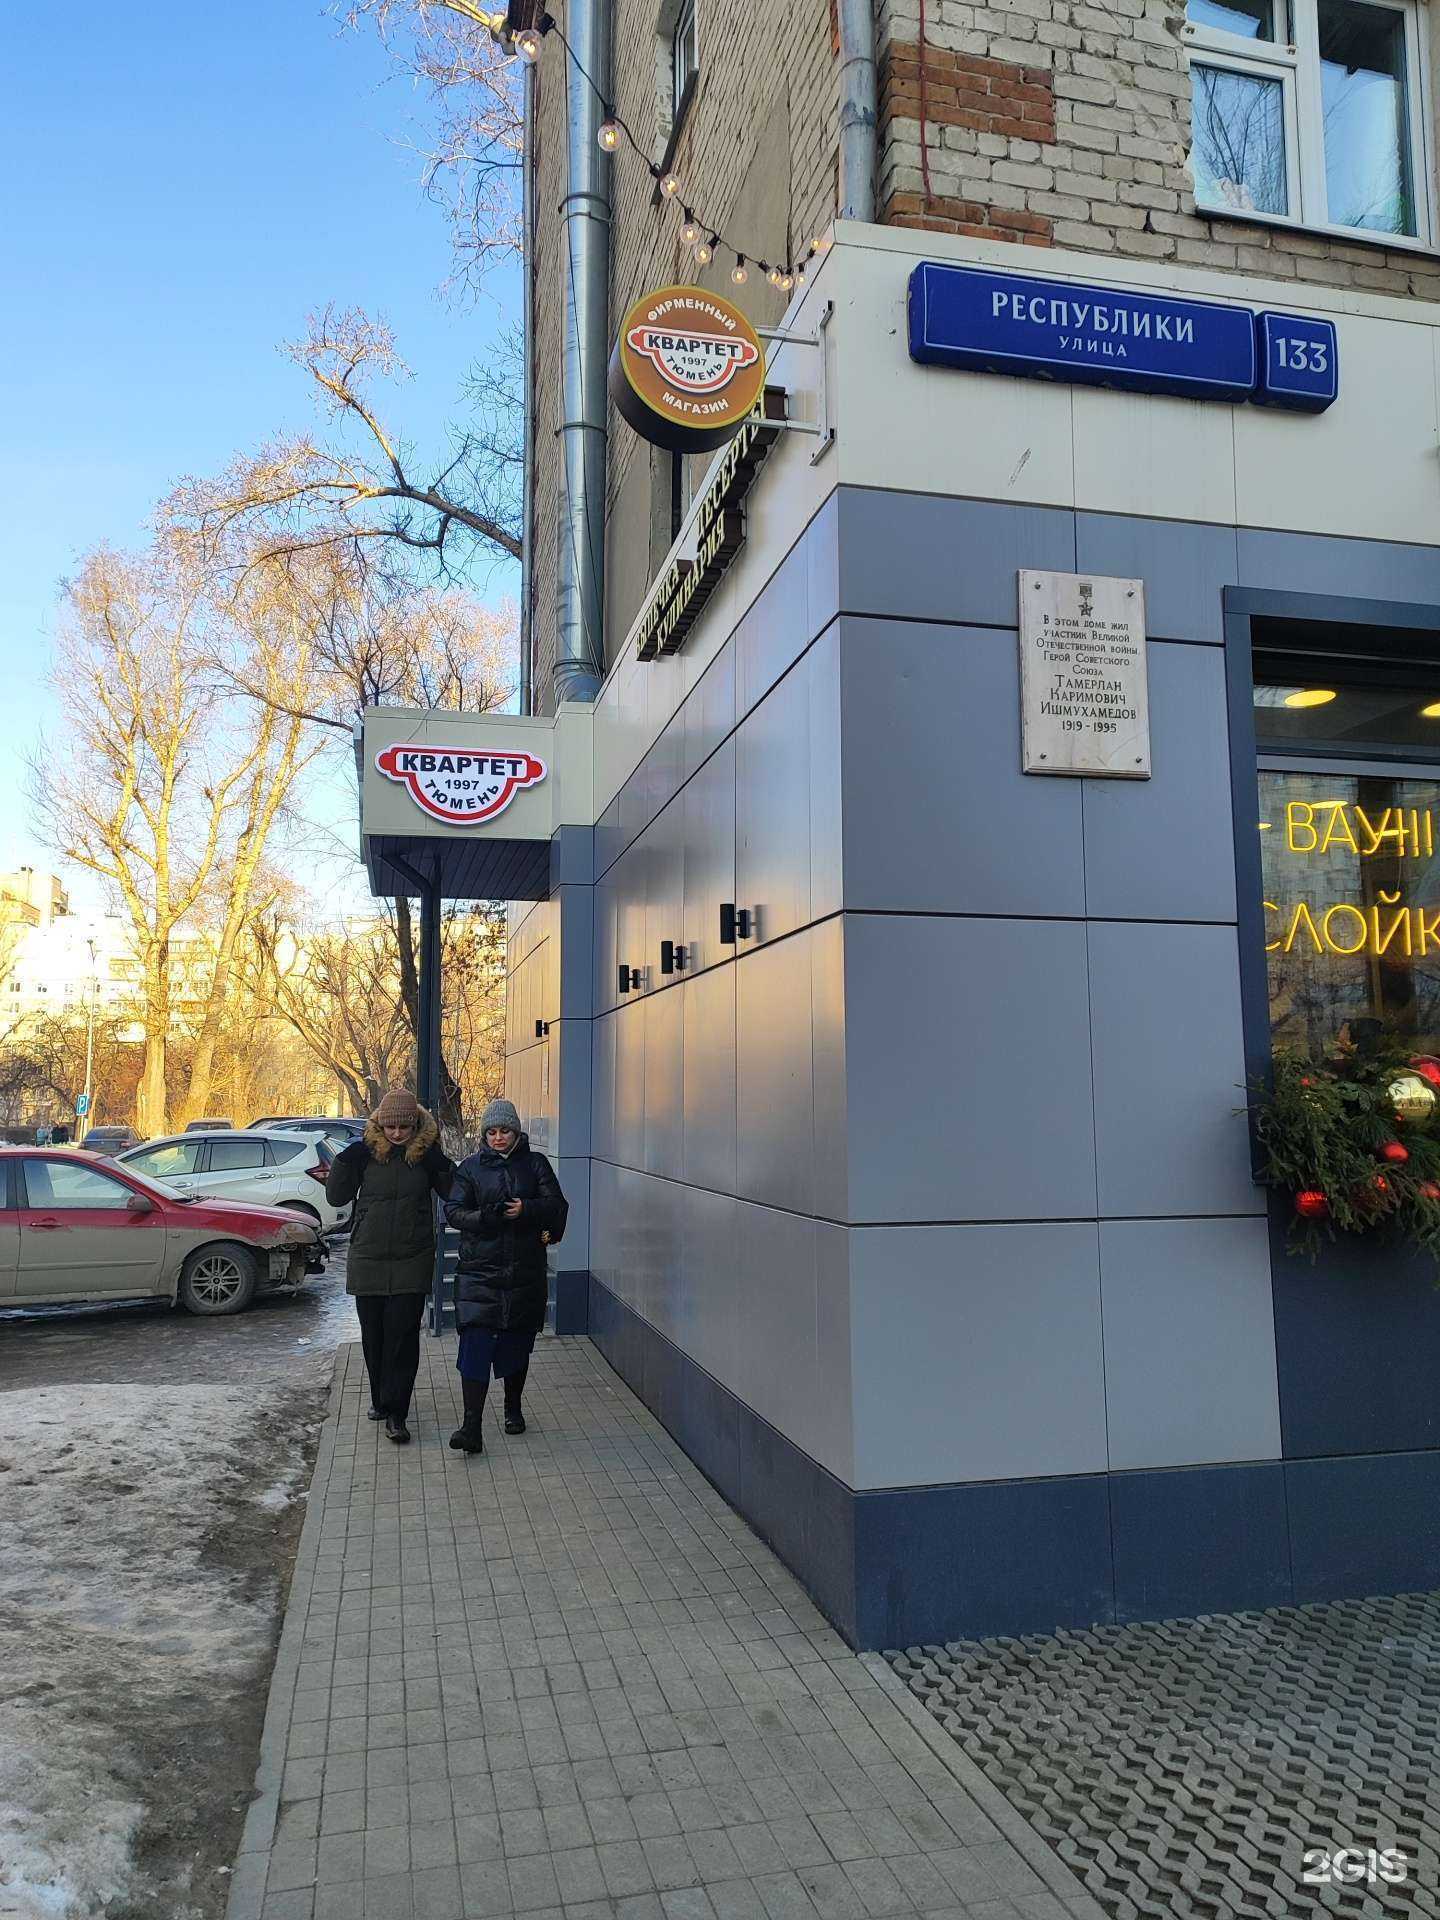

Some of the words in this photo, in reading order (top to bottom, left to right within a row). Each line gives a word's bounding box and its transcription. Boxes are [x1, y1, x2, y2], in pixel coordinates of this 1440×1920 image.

[647, 298, 737, 332] ФИРМЕННЫЙ
[991, 291, 1195, 344] РЕСПУБЛИКИ
[648, 334, 739, 358] КВАРТЕТ
[1058, 335, 1128, 358] УЛИЦА
[1274, 337, 1328, 374] 133
[666, 355, 723, 382] ТЮМЕНЬ
[681, 356, 707, 367] 1997
[662, 391, 730, 415] МАГАЗИН
[656, 507, 726, 655] КУЛИНАРИЯ
[1043, 614, 1050, 625] В
[1054, 618, 1079, 628] ЭТОМ
[1084, 620, 1107, 629] ДОМЕ
[1110, 622, 1129, 631] ЖИЛ
[1036, 637, 1106, 653] ОТЕЧЕСТВЕННОЙ
[1110, 645, 1138, 655] ВОЙНЫ
[1092, 630, 1130, 643] ВЕЛИКОЙ
[1043, 650, 1071, 662] ГЕРОЙ
[1075, 652, 1130, 666] СОВЕТСКОГО
[1072, 664, 1104, 676] СОЮЗА
[1054, 674, 1122, 692] ТАМЕРЛАН
[1050, 687, 1126, 705] КАРИМОВИЧ
[1040, 701, 1137, 720] ИШМУХАМЕДОВ
[402, 753, 523, 777] КВАРТЕТ
[424, 779, 500, 810] ТЮМЕНЬ
[445, 779, 480, 791] 1997
